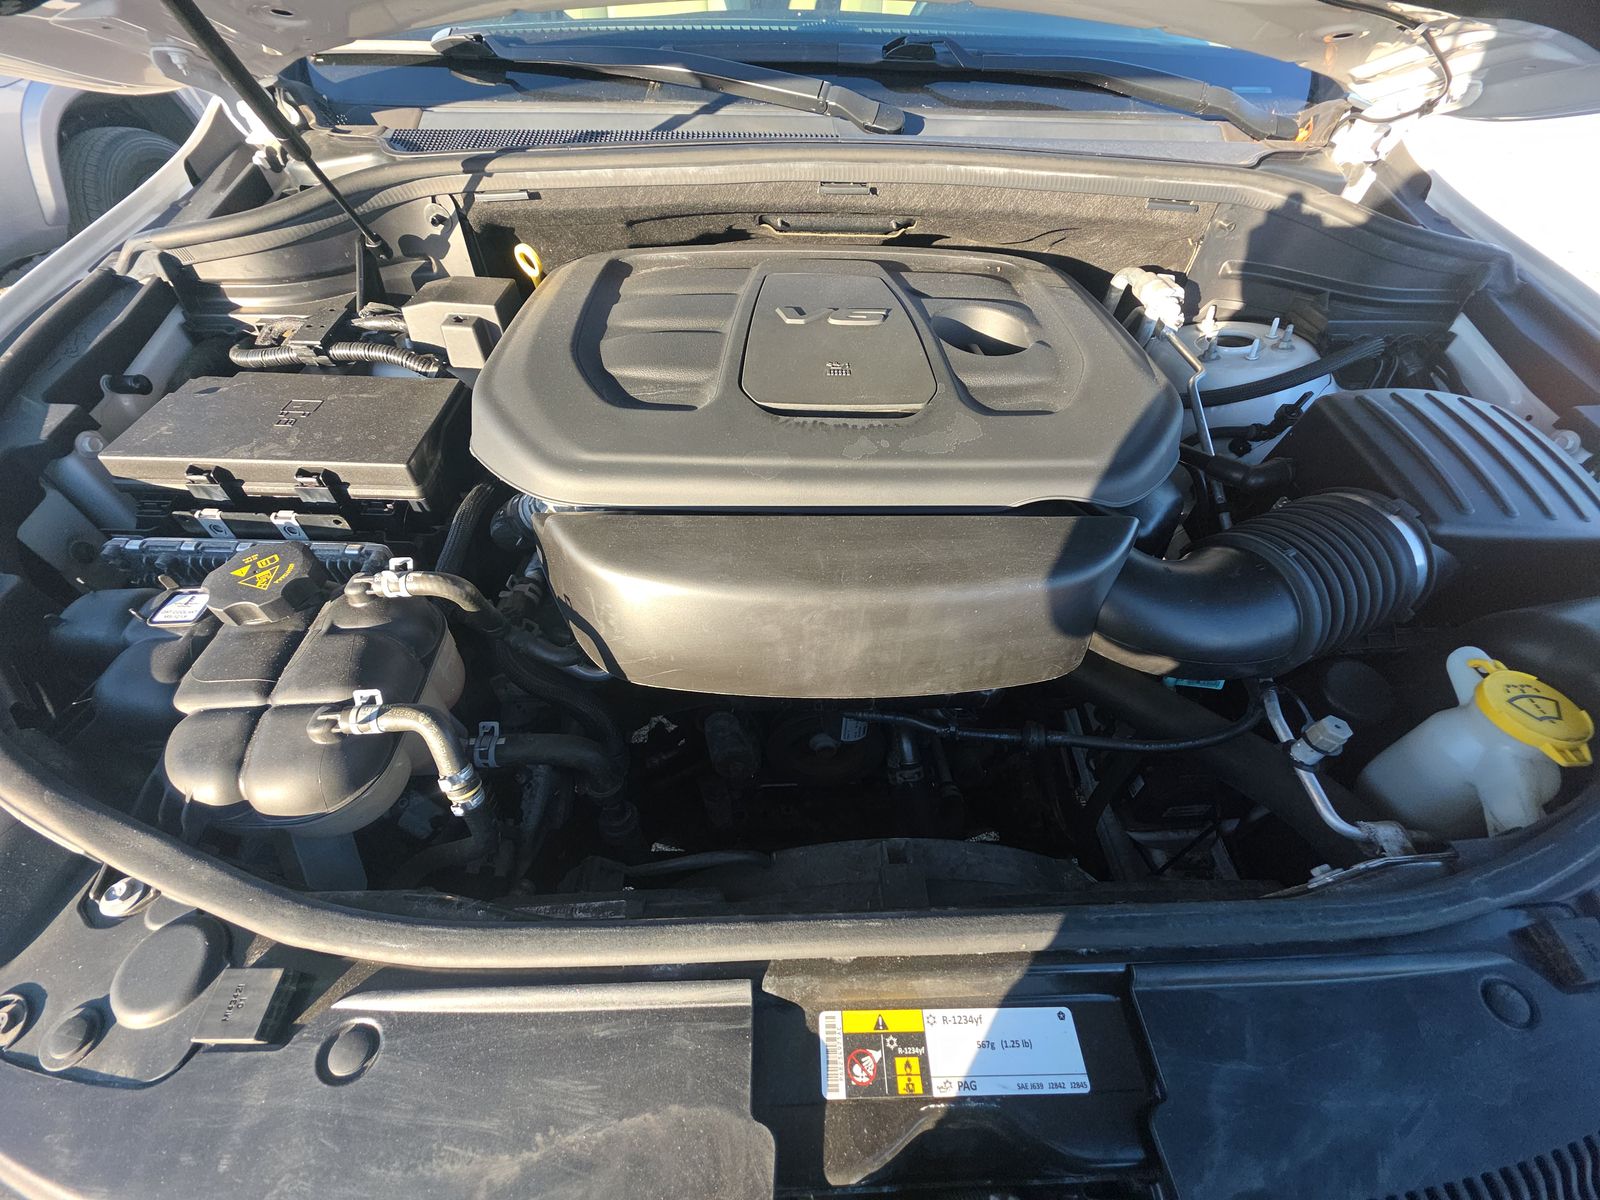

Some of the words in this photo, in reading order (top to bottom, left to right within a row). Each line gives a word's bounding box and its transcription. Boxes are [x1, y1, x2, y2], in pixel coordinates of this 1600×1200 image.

[775, 305, 891, 326] V6
[941, 1014, 983, 1027] R-1234yf
[976, 1040, 996, 1051] 567g
[1000, 1039, 1020, 1051] (1.25
[897, 1046, 925, 1056] R-1234yf
[957, 1080, 978, 1091] PAG
[1017, 1082, 1029, 1090] SAE
